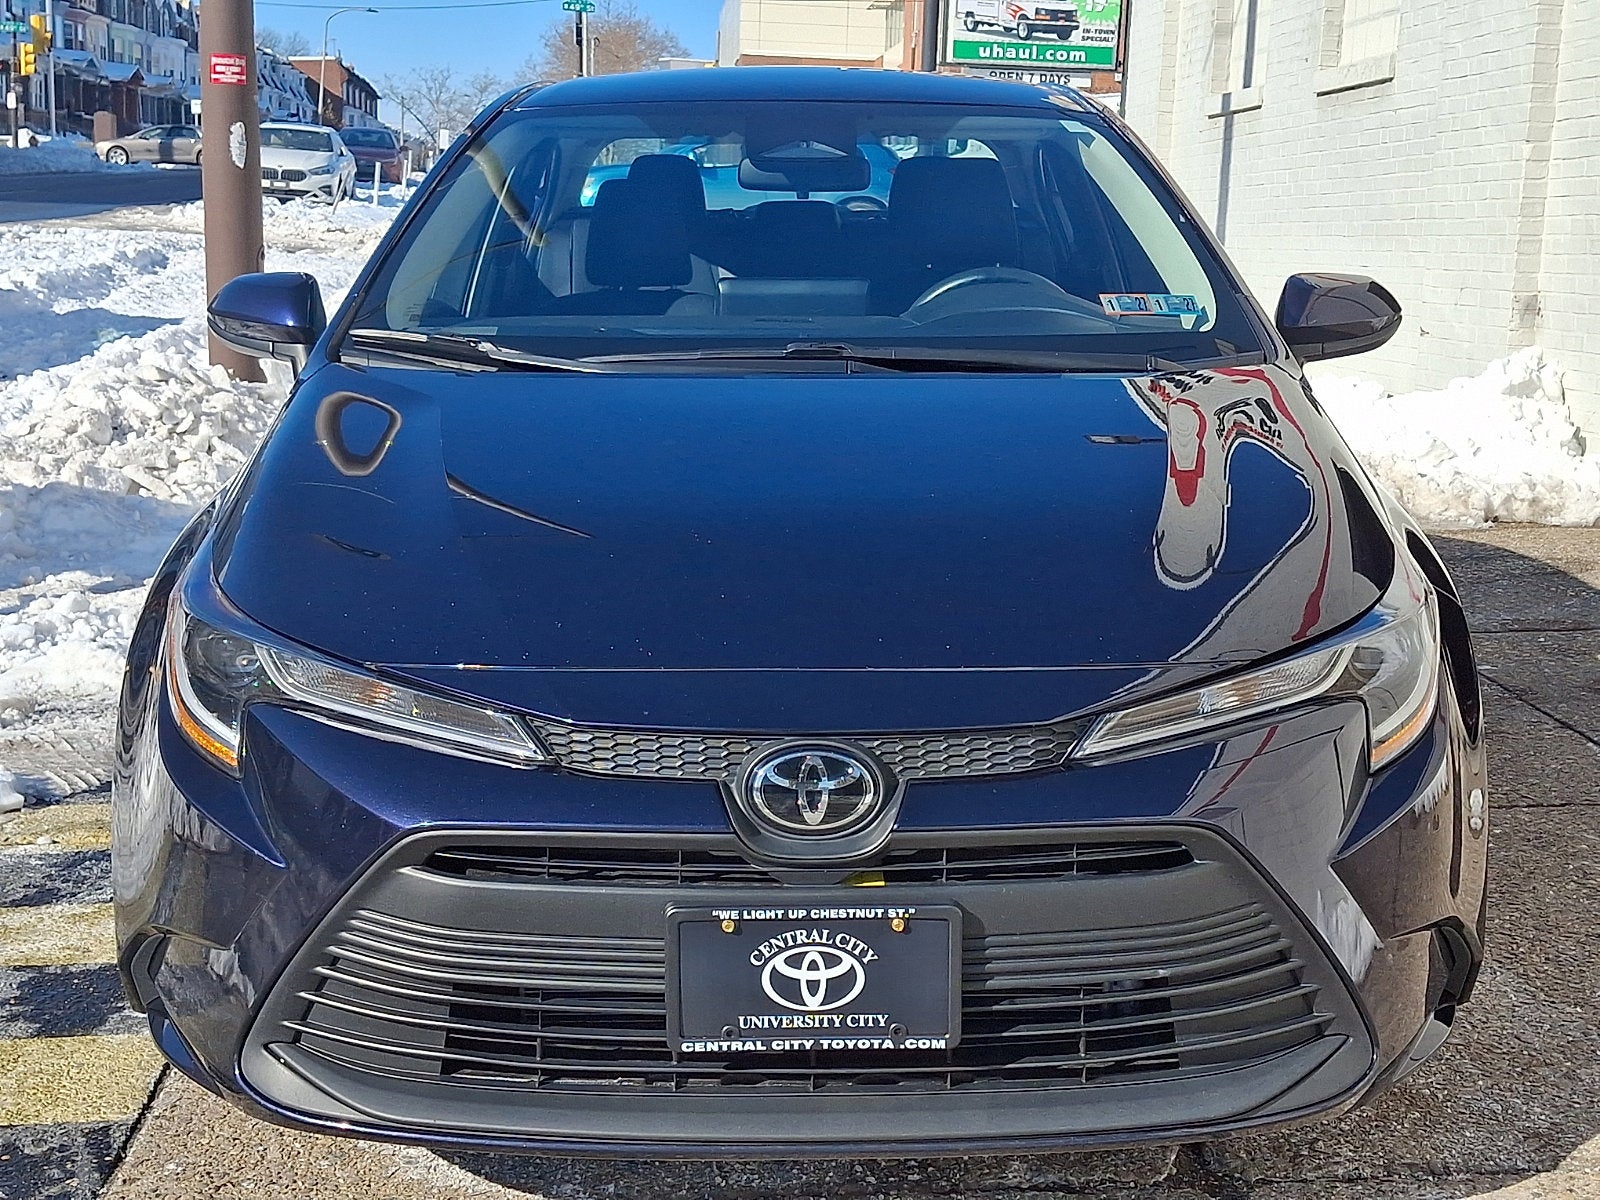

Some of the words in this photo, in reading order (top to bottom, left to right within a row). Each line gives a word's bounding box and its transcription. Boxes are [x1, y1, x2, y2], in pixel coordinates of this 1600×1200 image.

[1082, 27, 1116, 36] IN-TOWN
[1080, 35, 1115, 43] SPECIAL!
[978, 43, 1087, 63] uhaul.com
[1028, 73, 1035, 83] 7
[1039, 73, 1071, 85] DAYS
[1135, 297, 1148, 312] 27
[742, 909, 785, 920] LIGHT
[787, 909, 807, 919] UP
[810, 908, 885, 919] CHESTNUT
[749, 928, 834, 967] CENTRAL
[834, 932, 879, 965] CITY
[738, 1014, 843, 1029] UNIVERSITY
[845, 1013, 889, 1028] CITY
[681, 1039, 767, 1052] CENTRAL
[770, 1039, 815, 1051] CITY
[819, 1038, 895, 1050] TOYOTA
